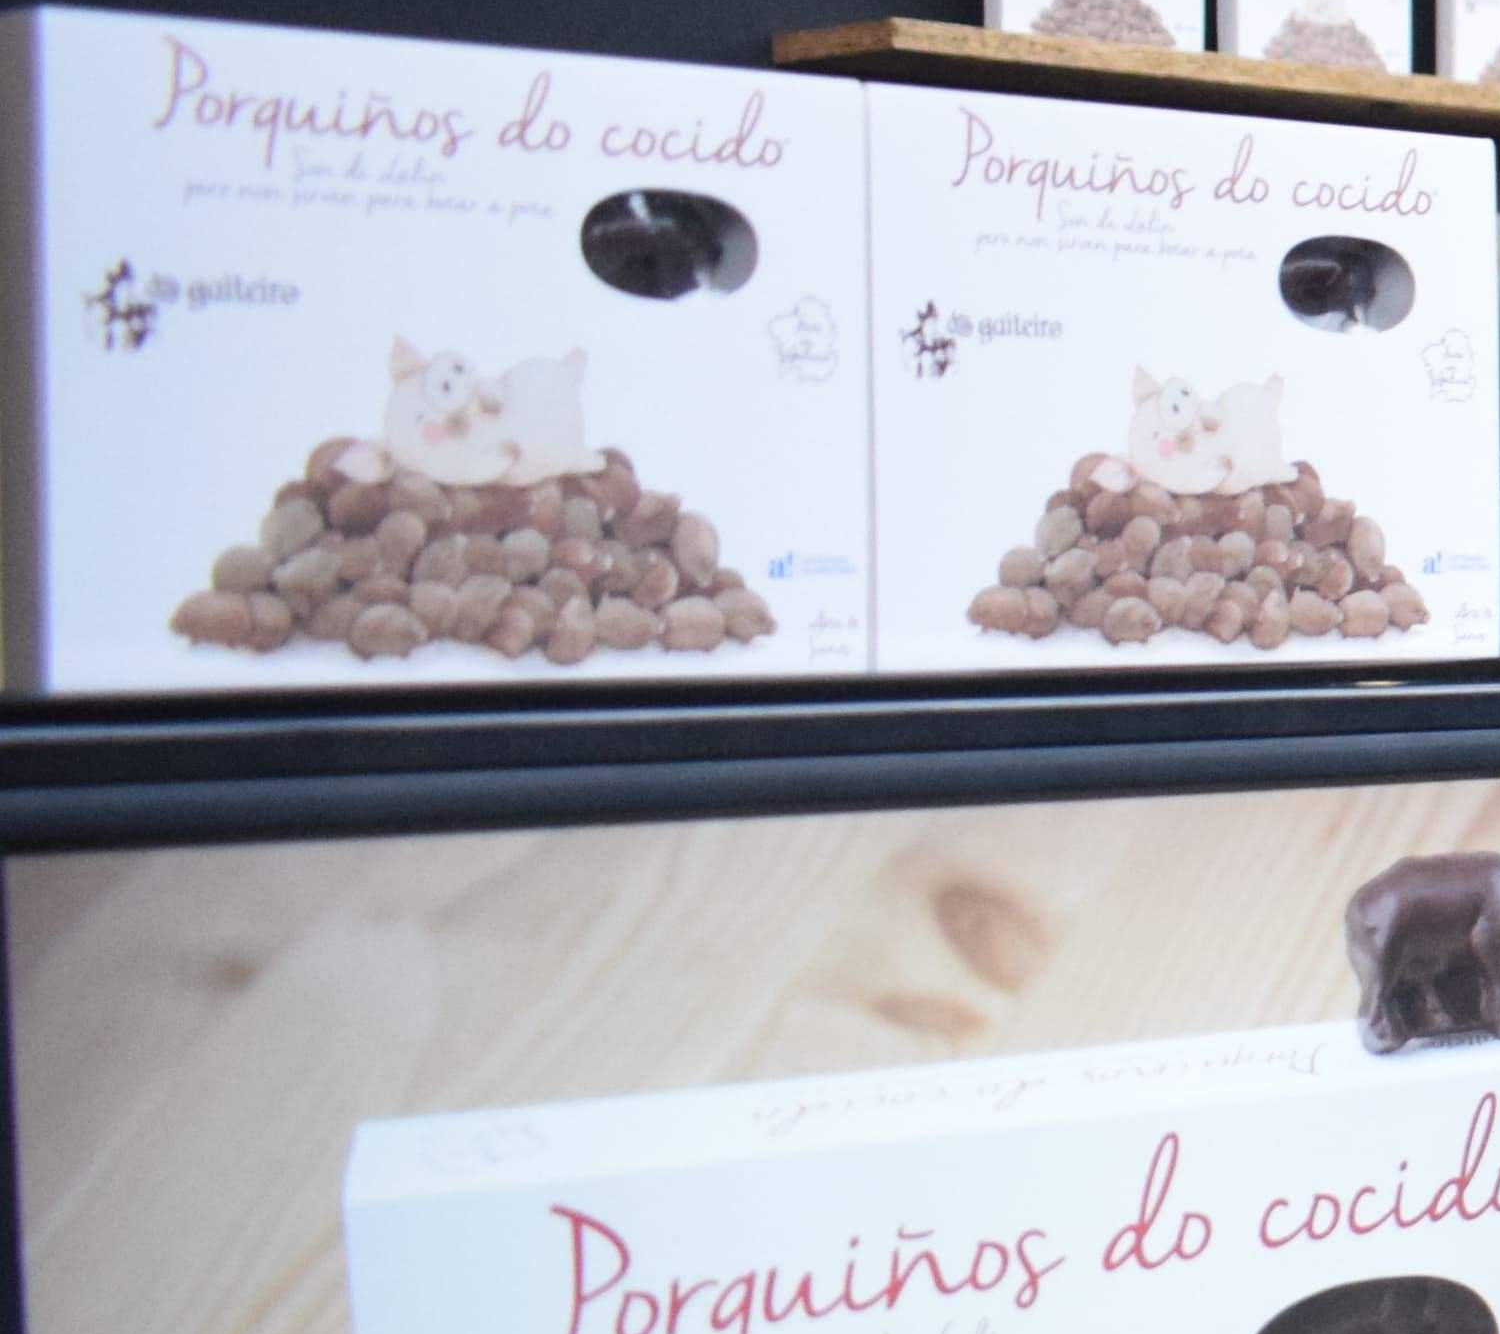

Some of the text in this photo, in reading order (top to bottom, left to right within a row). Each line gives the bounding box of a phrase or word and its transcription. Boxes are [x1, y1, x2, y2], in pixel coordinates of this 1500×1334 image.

[153, 36, 785, 168] Porquiños do cocido
[953, 107, 1434, 220] Porquiños do cocido
[1103, 1133, 1212, 1272] do
